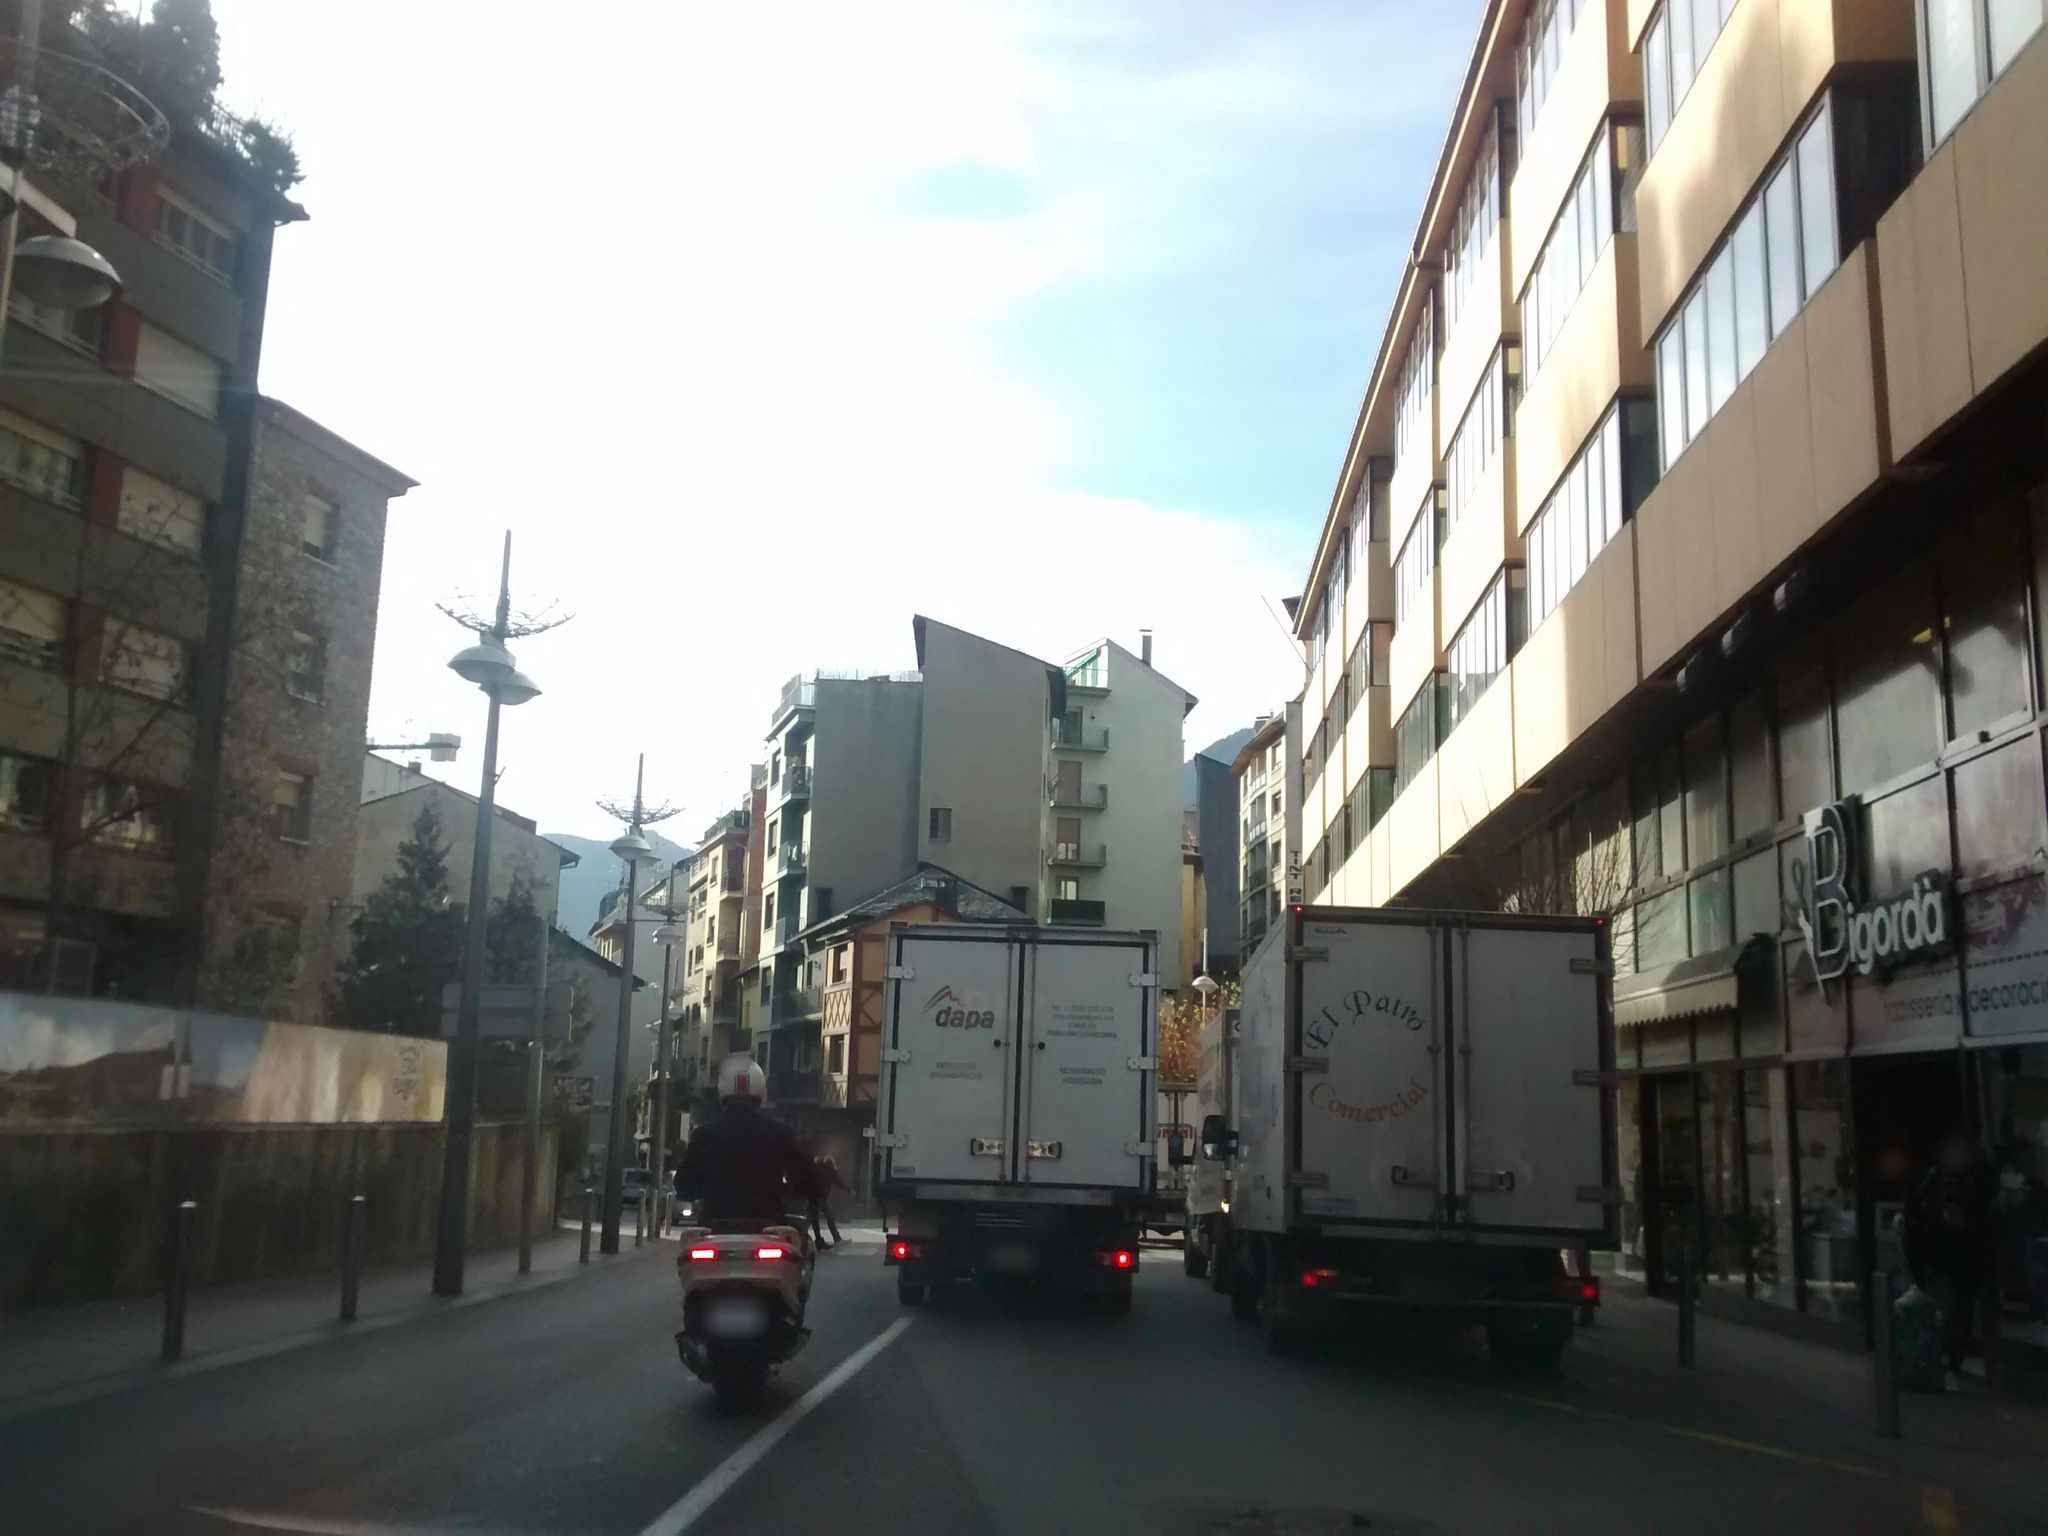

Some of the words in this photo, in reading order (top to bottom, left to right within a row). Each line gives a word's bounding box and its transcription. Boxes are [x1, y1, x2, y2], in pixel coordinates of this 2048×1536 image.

[1804, 805, 1946, 980] Bigordà
[935, 1006, 995, 1031] dapa
[1304, 1006, 1339, 1049] El
[1343, 990, 1428, 1032] Patró
[1309, 1077, 1428, 1122] Comercial
